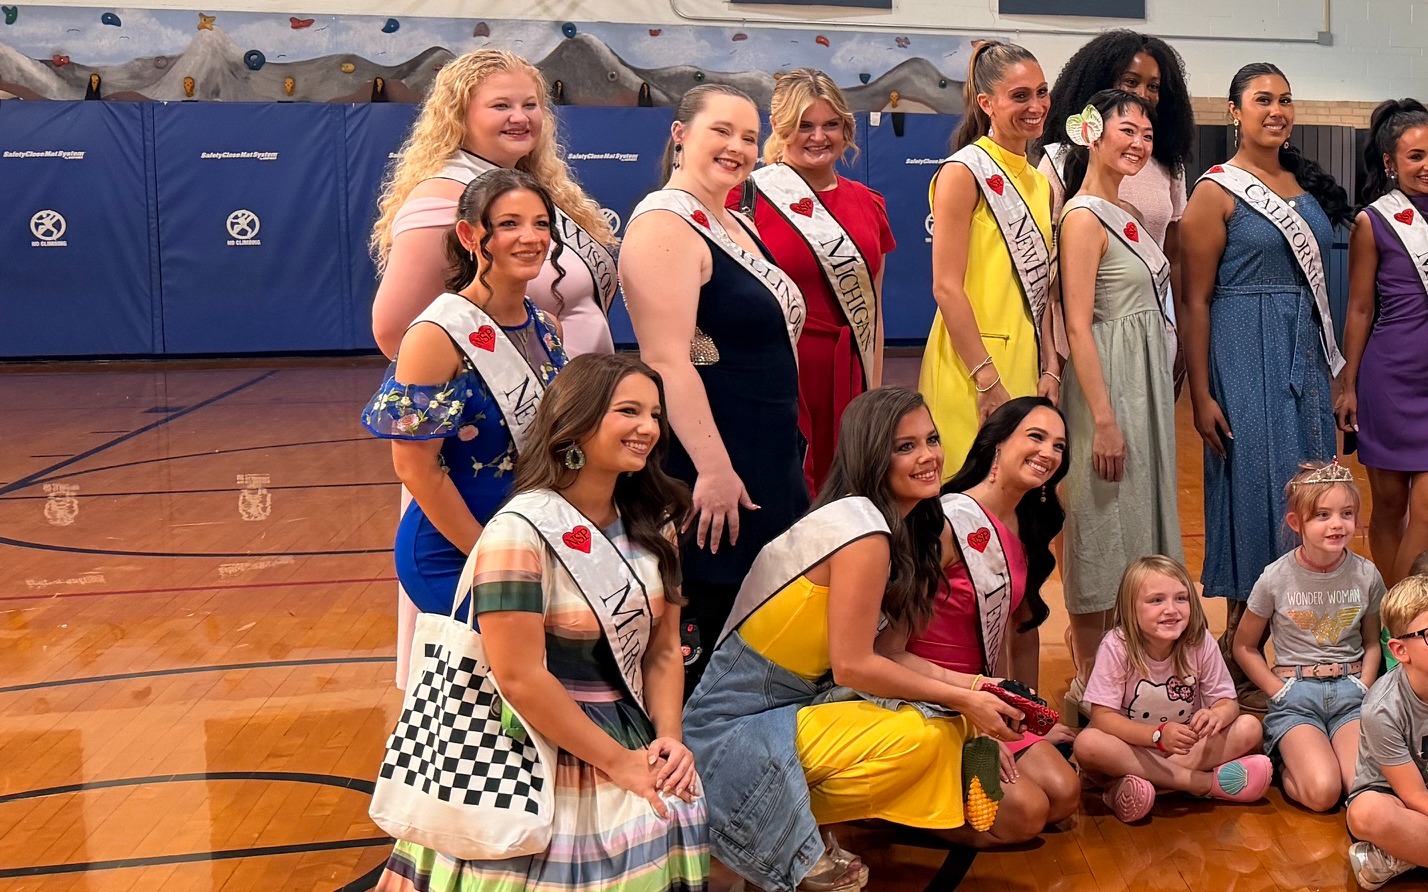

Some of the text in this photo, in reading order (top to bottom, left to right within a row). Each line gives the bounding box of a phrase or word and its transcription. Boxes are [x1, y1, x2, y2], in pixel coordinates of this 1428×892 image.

[1244, 183, 1320, 296] CALIFORNIA
[819, 232, 874, 352] MICHIGAN
[473, 328, 493, 345] NSP
[567, 528, 588, 546] NSP
[971, 531, 989, 546] NSP
[1287, 588, 1361, 606] WONDER WOMAN
